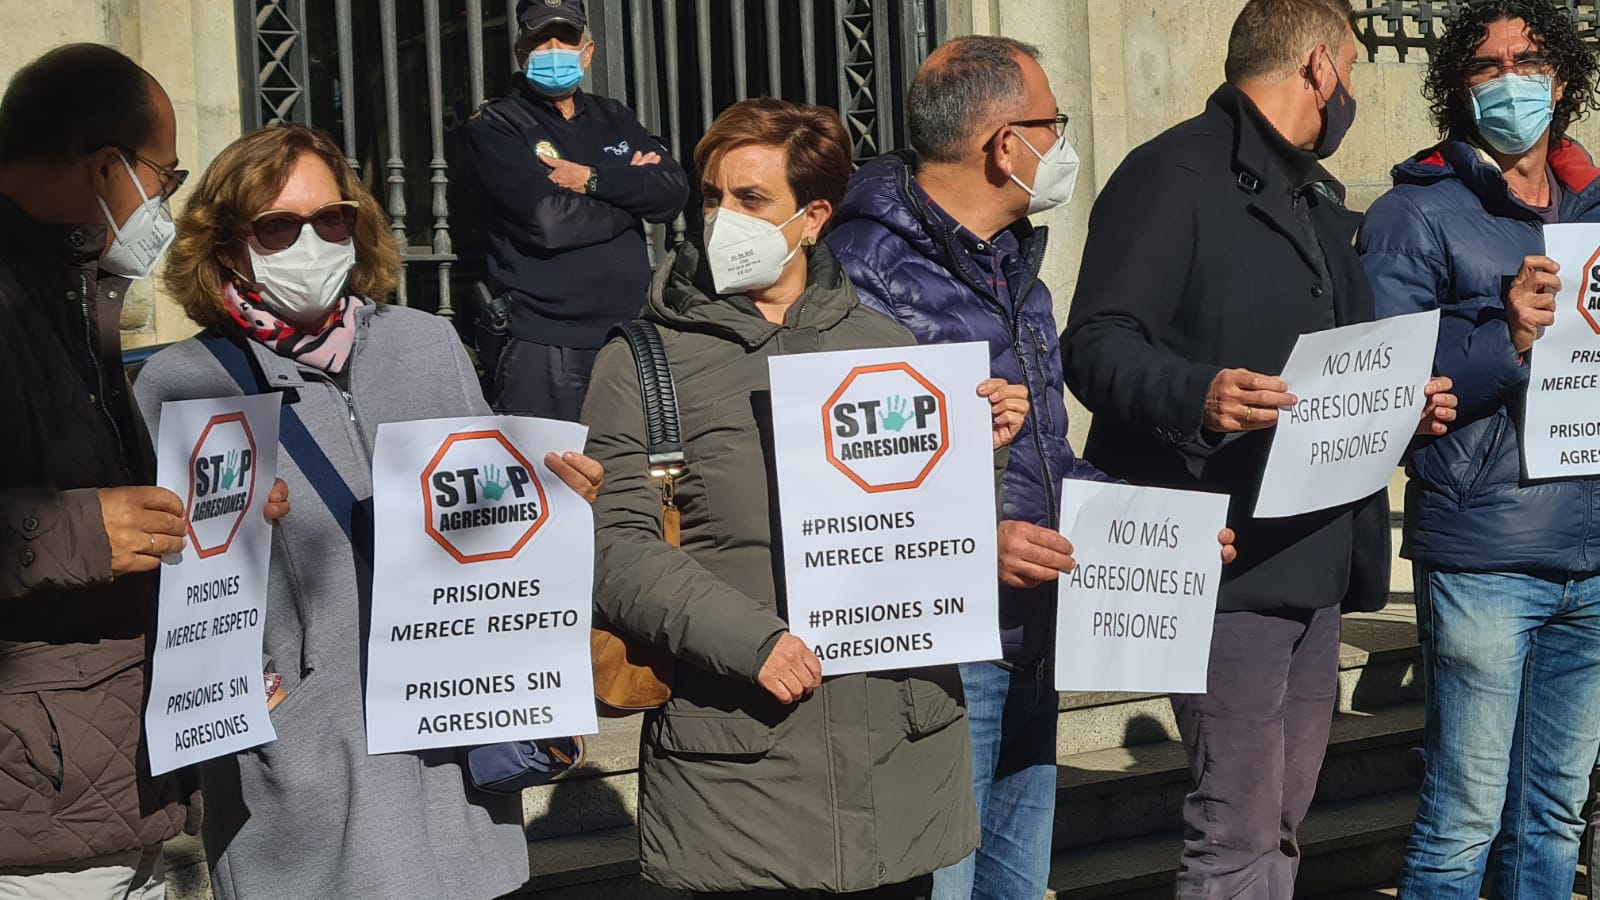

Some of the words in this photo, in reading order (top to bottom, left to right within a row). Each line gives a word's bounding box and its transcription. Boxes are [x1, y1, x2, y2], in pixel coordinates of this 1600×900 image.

[1322, 354, 1350, 376] NO
[1354, 342, 1392, 372] MÁS
[1541, 374, 1598, 391] MERECE
[1290, 388, 1389, 424] AGRESIONES
[1394, 385, 1415, 409] EN
[841, 433, 938, 461] AGRESIONES
[1310, 430, 1389, 465] PRISIONES
[1560, 449, 1600, 465] AGRE
[192, 491, 247, 522] AGRESIONES
[439, 501, 538, 532] AGRESIONES
[801, 511, 915, 536] #PRISIONES
[1108, 519, 1136, 544] NO
[1140, 517, 1179, 548] MÁS
[805, 545, 884, 568] MERECE
[895, 537, 976, 560] RESPETO
[187, 575, 240, 605] PRISIONES
[433, 579, 541, 605] PRISIONES
[1070, 563, 1178, 594] AGRESIONES
[1184, 571, 1206, 596] EN
[391, 618, 475, 642] MERECE
[487, 609, 578, 633] RESPETO
[808, 601, 922, 628] #PRISIONES
[933, 597, 965, 616] SIN
[1093, 612, 1178, 640] PRISIONES
[165, 620, 207, 649] MERECE
[212, 608, 258, 635] RESPETO
[814, 633, 933, 660] AGRESIONES
[166, 682, 224, 715] PRISIONES
[230, 675, 248, 697] SIN
[405, 674, 515, 700] PRISIONES
[528, 671, 562, 690] SIN
[175, 713, 249, 752] AGRESIONES
[417, 706, 553, 735] AGRESIONES
